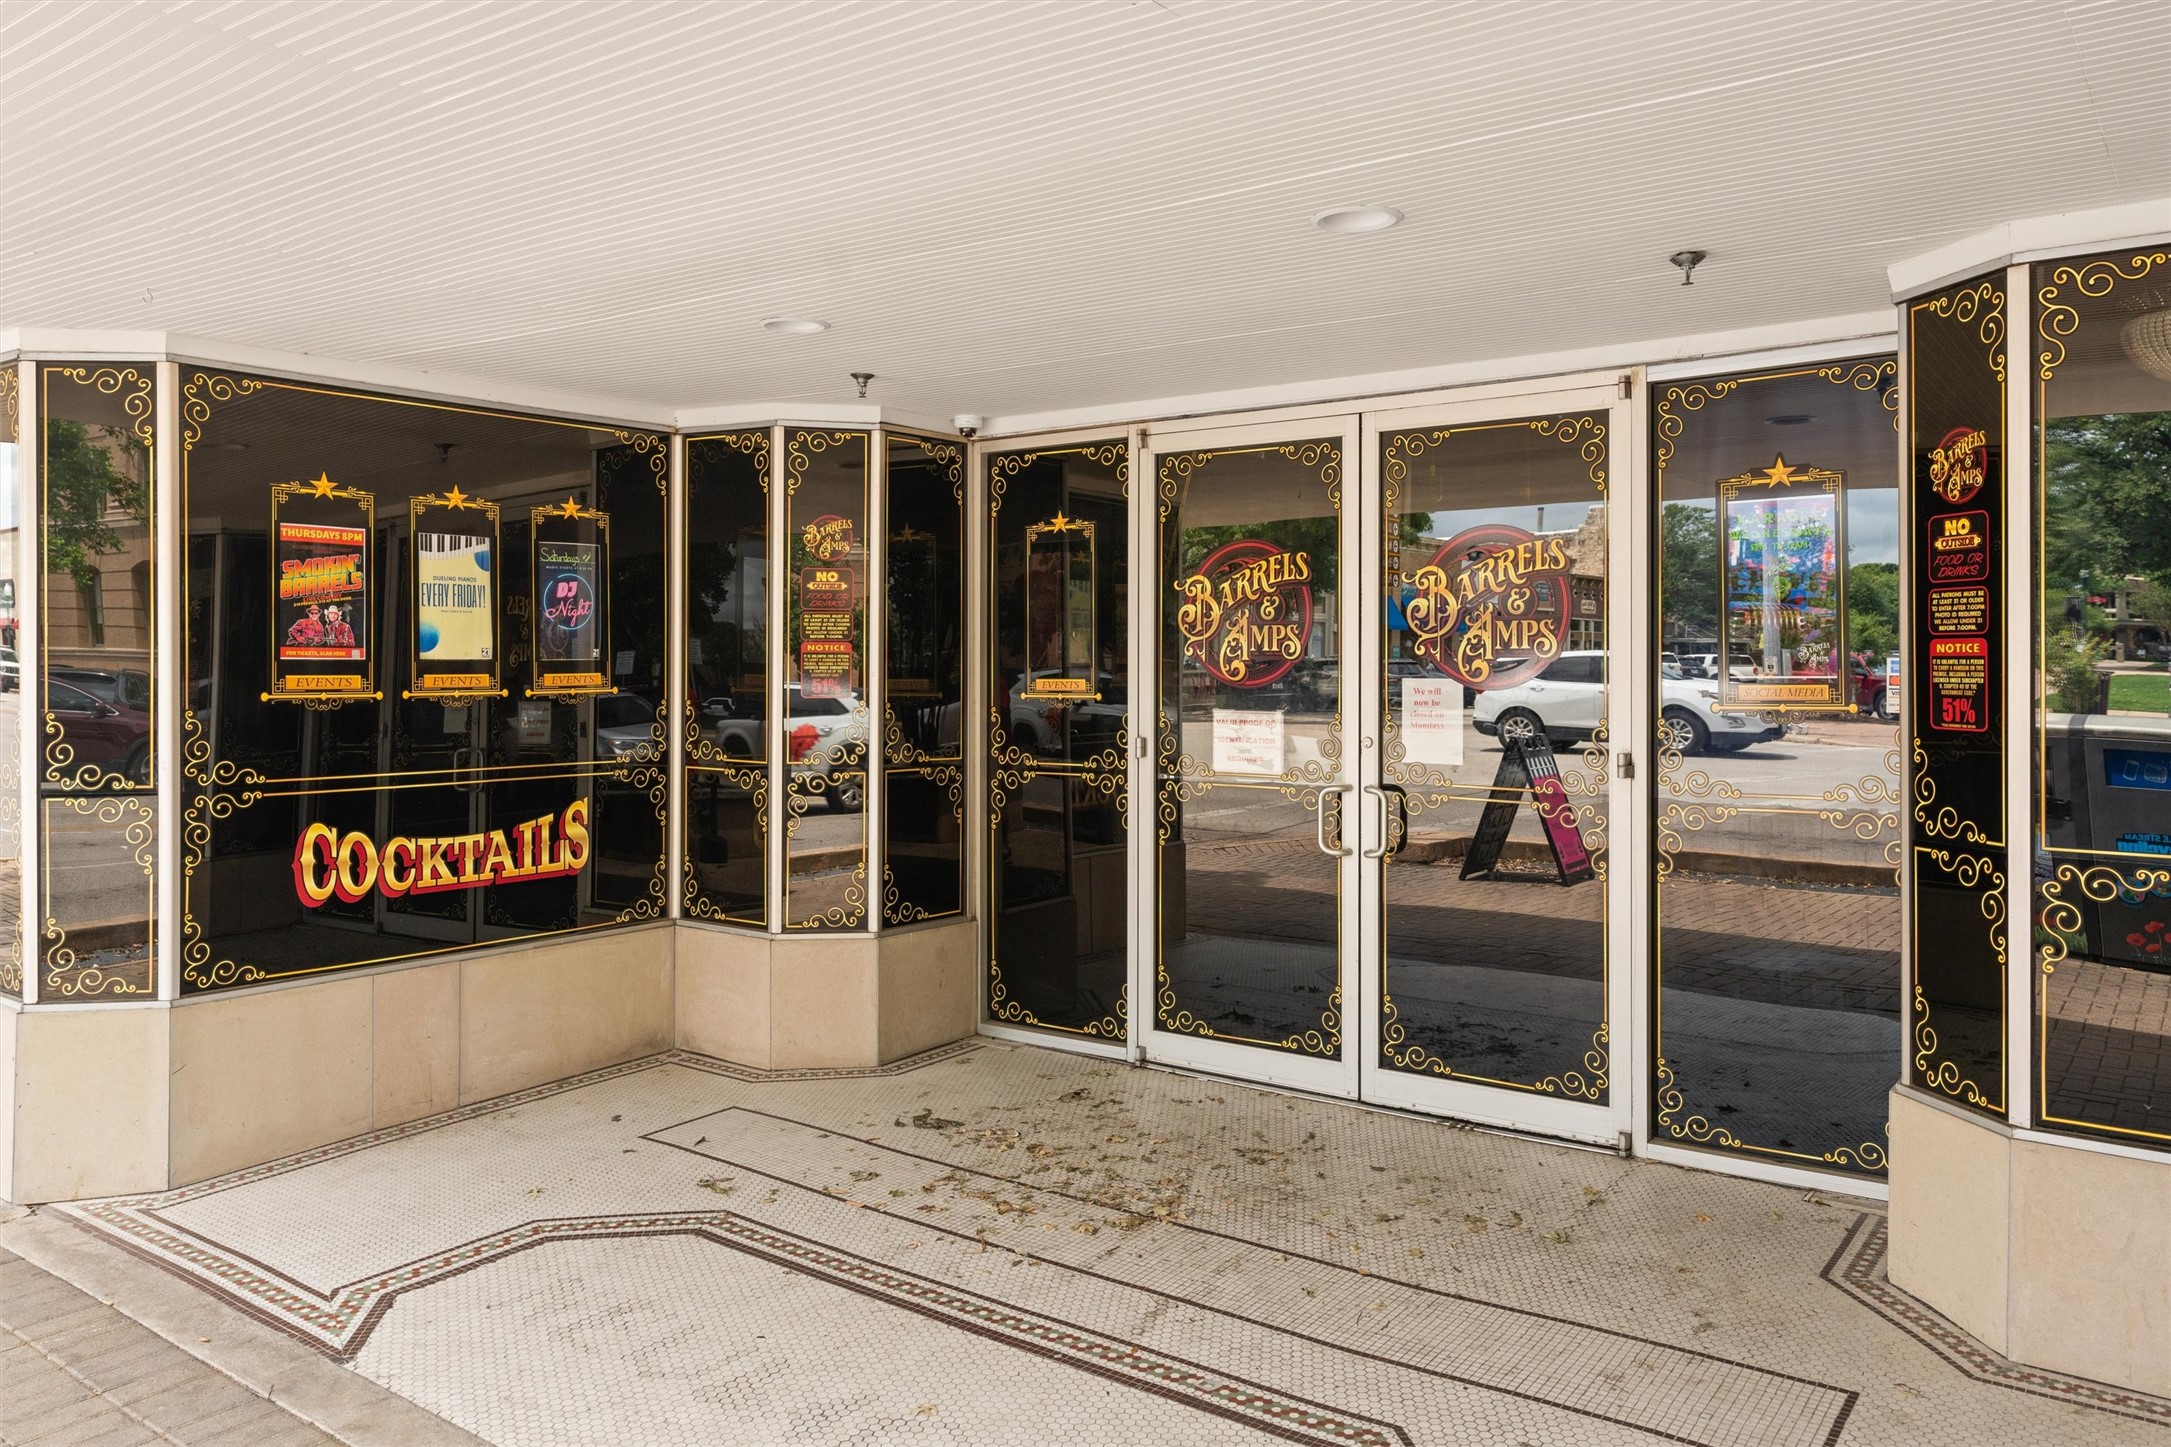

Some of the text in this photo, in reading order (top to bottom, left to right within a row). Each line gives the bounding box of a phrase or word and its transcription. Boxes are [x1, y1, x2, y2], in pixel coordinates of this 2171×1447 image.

[1965, 455, 1974, 468] &
[1944, 518, 1970, 536] NO
[281, 528, 363, 542] THURSDAYS 8PM
[835, 532, 842, 540] &
[1941, 536, 1975, 548] OUTSIDE
[540, 547, 580, 566] Saturdays
[1934, 552, 1984, 566] FOOD OR
[282, 554, 362, 579] SMOKIN'
[1938, 565, 1979, 578] DRINKS
[816, 572, 838, 582] NO
[280, 571, 364, 600] BARRELS
[556, 582, 578, 598] DJ
[421, 583, 450, 608] EVERY
[452, 584, 486, 608] FRIDAY!
[1507, 588, 1530, 614] &
[545, 599, 592, 627] Night
[1260, 596, 1280, 621] &
[1936, 644, 1980, 653] NOTICE
[296, 678, 352, 687] EVENTS
[432, 676, 482, 686] EVENTS
[551, 675, 596, 685] EVENTS
[812, 678, 841, 693] 51%
[1042, 681, 1080, 689] EVENTS
[1744, 688, 1824, 697] SOCIAL MEDIA
[1943, 698, 1976, 723] 51%
[292, 797, 590, 908] COCKTAILS
